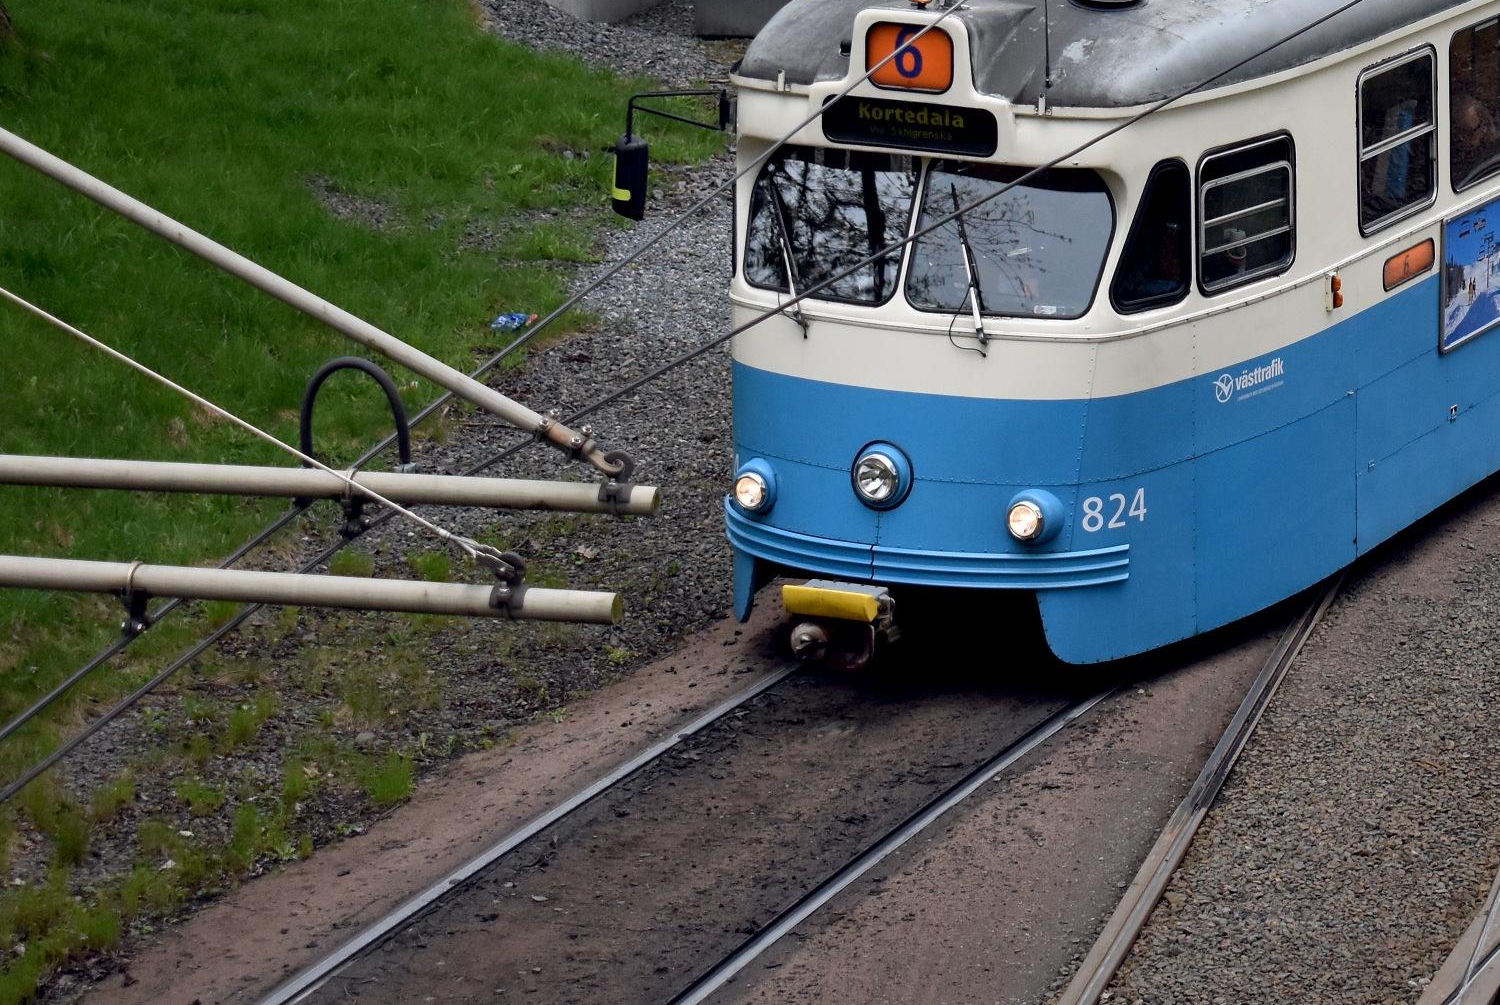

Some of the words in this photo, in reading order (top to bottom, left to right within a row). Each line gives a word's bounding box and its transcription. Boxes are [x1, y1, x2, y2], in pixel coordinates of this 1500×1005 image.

[895, 26, 923, 79] 6
[858, 102, 965, 128] Kortedala
[1235, 357, 1284, 391] västtrafik
[1082, 488, 1147, 532] 824
